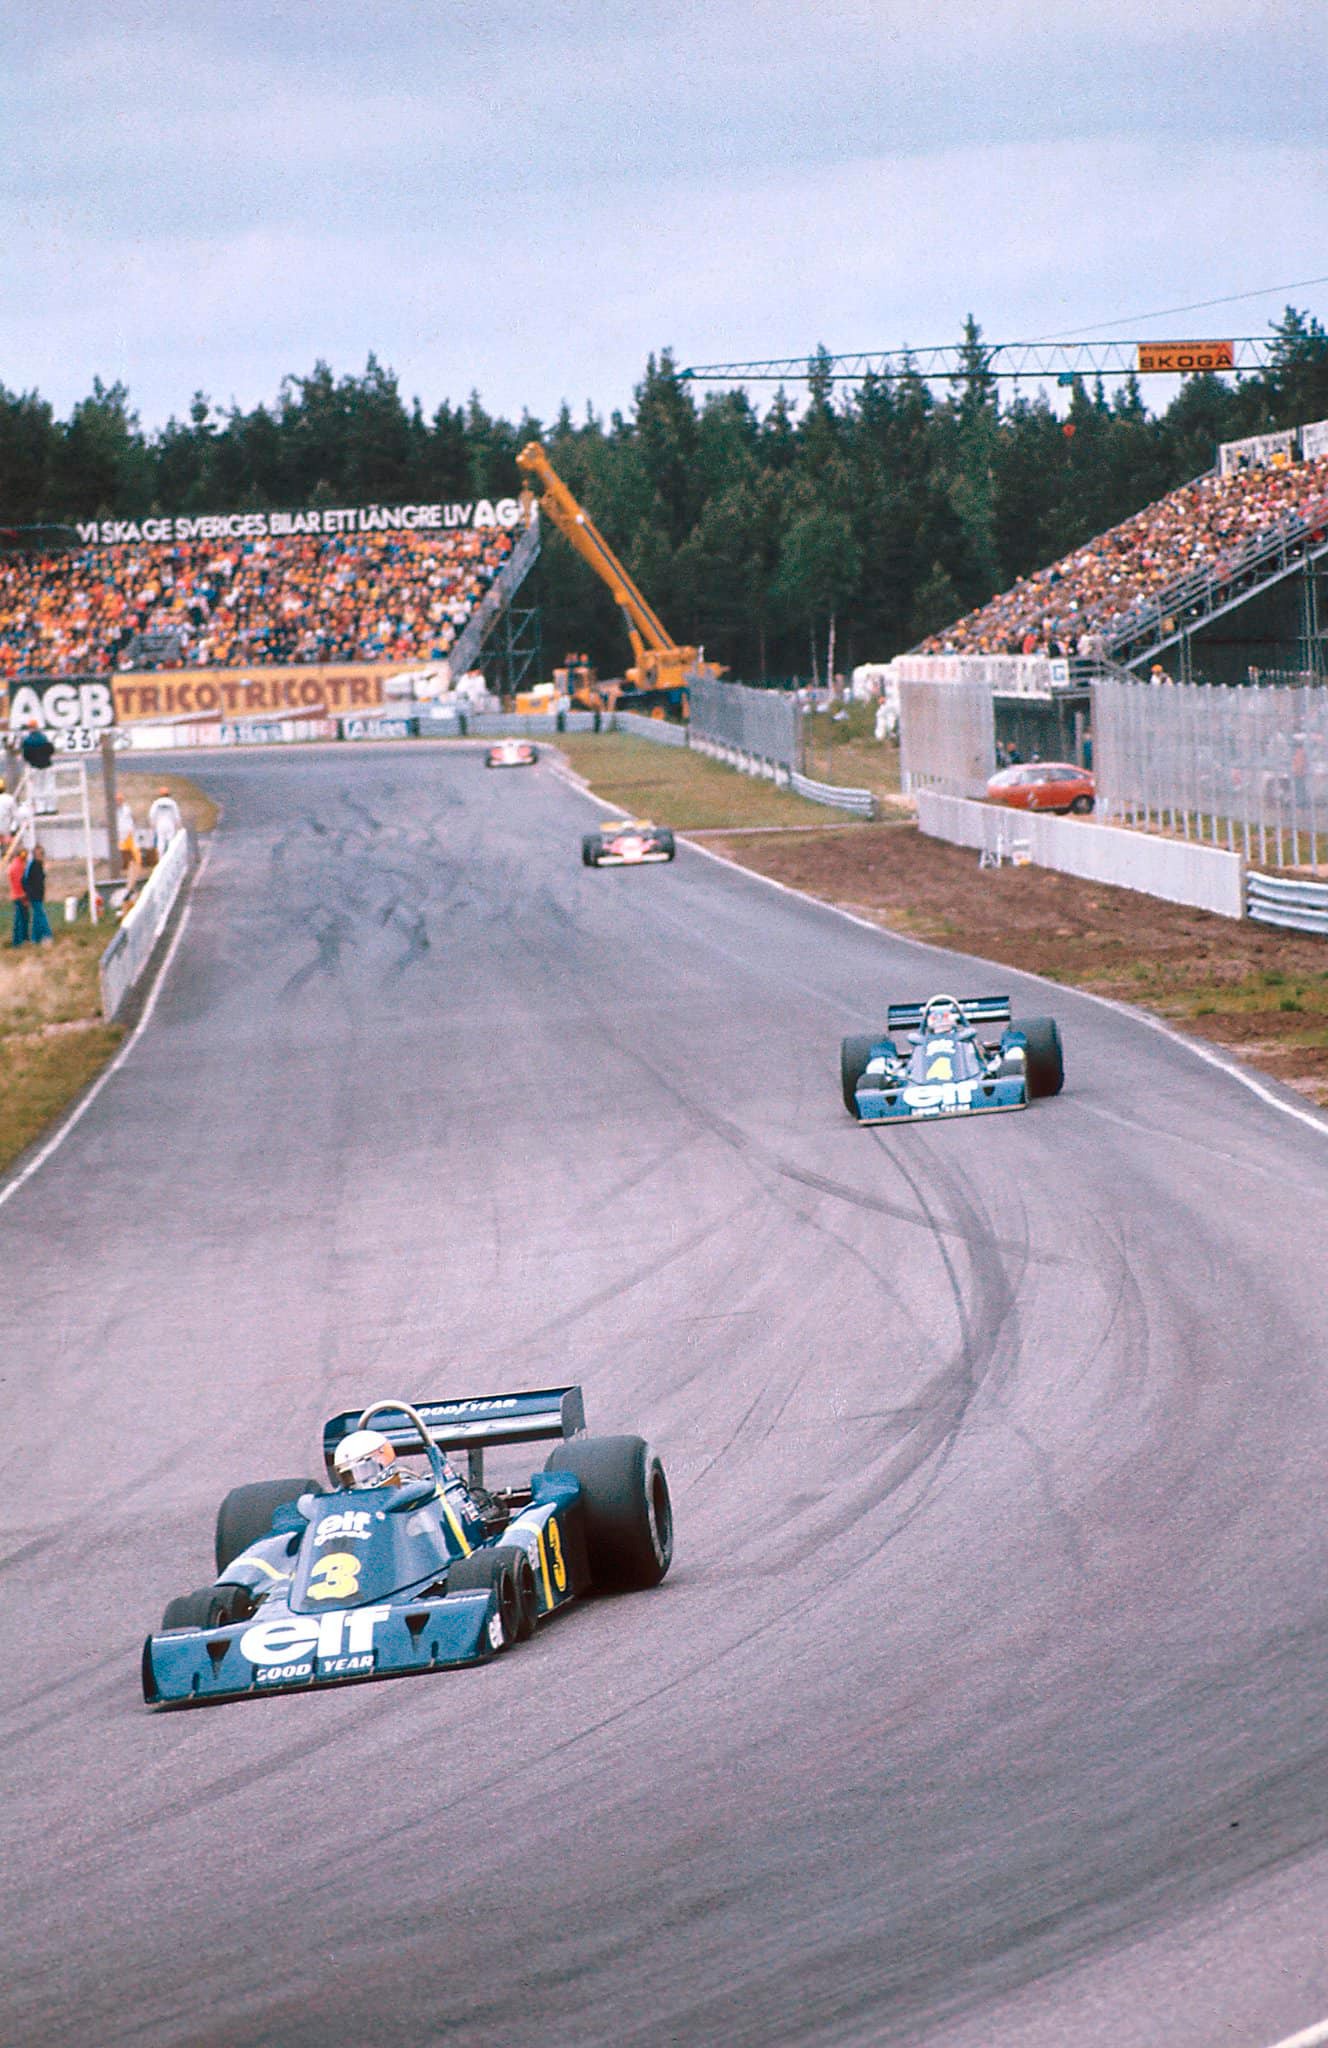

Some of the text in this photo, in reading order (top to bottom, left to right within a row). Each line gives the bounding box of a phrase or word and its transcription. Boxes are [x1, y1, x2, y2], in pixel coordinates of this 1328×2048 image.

[76, 521, 99, 543] VI
[101, 520, 142, 544] SKA
[142, 518, 173, 542] GE
[175, 514, 268, 541] SVERIGES
[270, 511, 321, 535] BILAR
[323, 508, 358, 532] ETT
[359, 504, 443, 531] LÄNGRE
[444, 502, 473, 527] LIV
[9, 683, 114, 730] AGB
[903, 1080, 978, 1108] elf
[316, 1510, 371, 1535] elf
[306, 1552, 361, 1600] 3
[549, 1517, 567, 1592] 3
[240, 1604, 392, 1665] elf
[324, 1655, 375, 1673] YEAR
